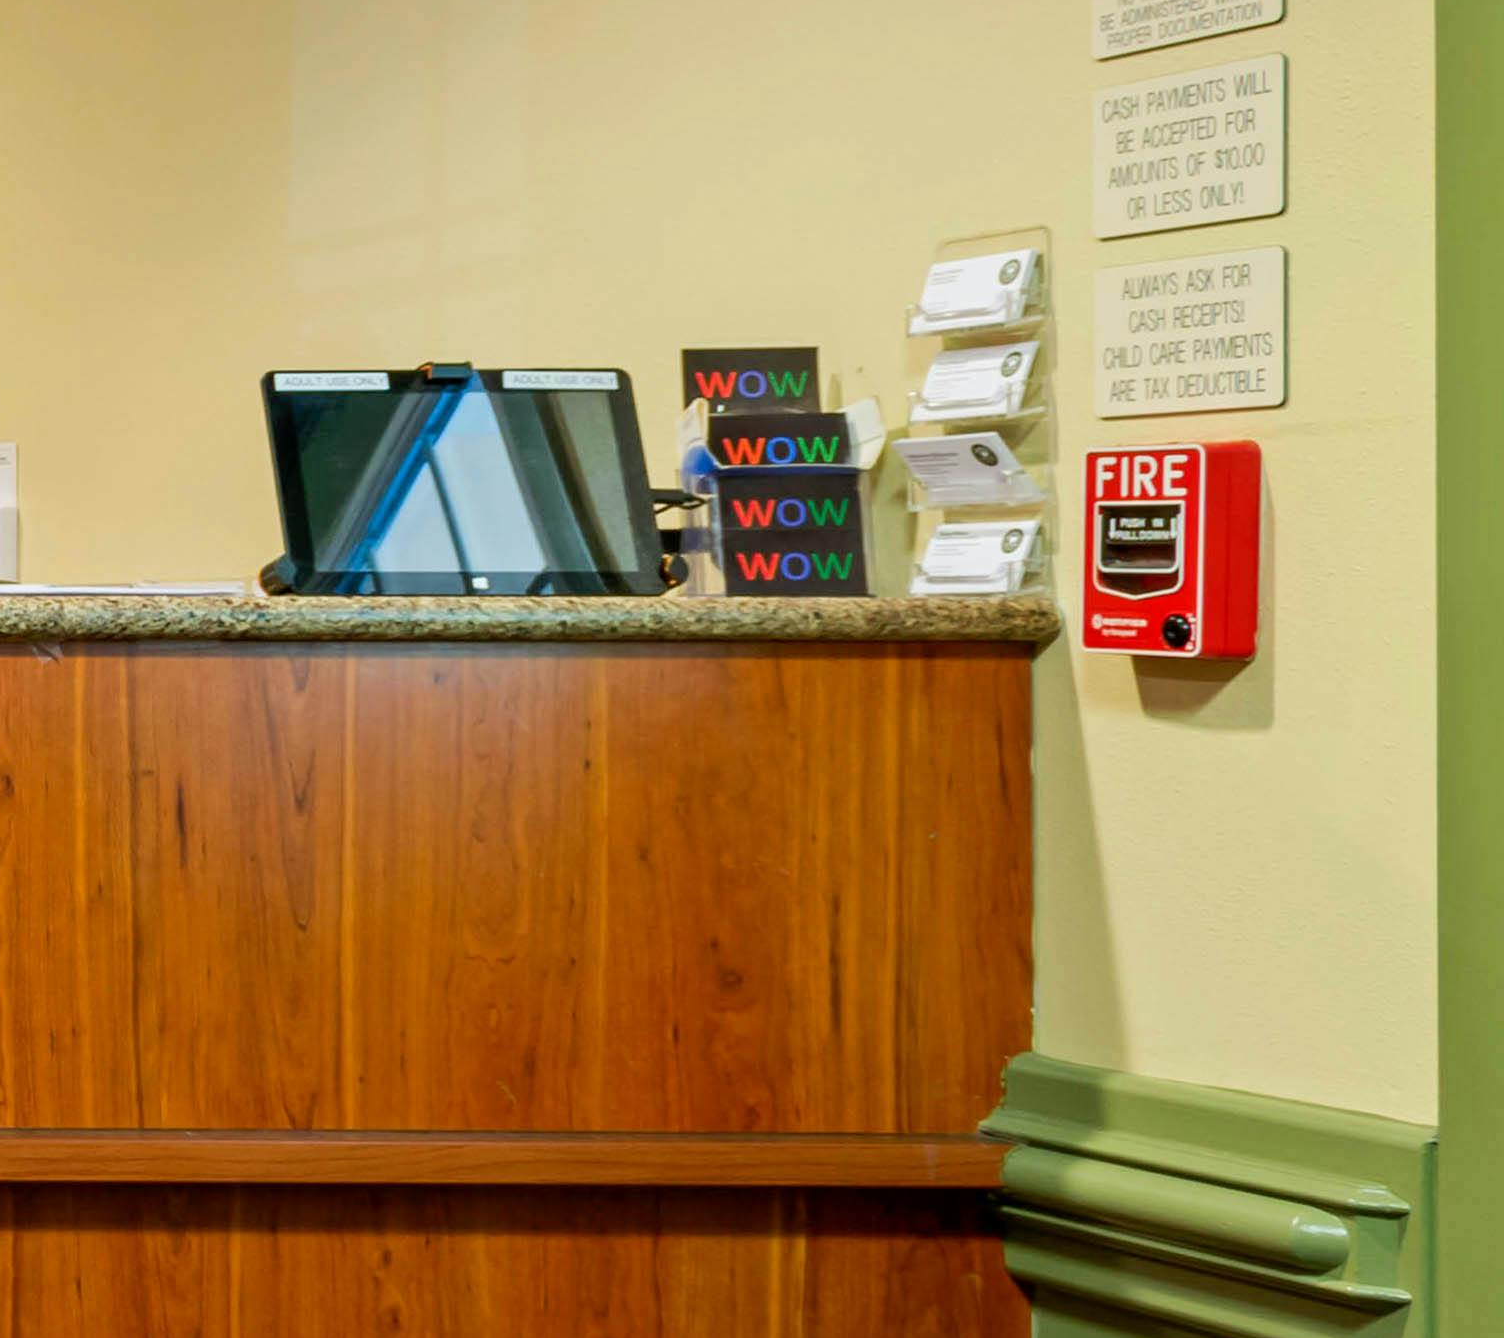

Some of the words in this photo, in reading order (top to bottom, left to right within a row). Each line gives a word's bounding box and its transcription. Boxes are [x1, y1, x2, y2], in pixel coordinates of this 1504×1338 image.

[1100, 14, 1115, 32] BE
[1107, 26, 1152, 48] PROPER
[1158, 3, 1263, 39] DOCUMENTATION
[1102, 95, 1140, 124] CASH
[1147, 78, 1226, 115] PAYMENTS
[1233, 69, 1272, 99] WILL
[1116, 129, 1135, 155] BE
[1141, 116, 1217, 149] ACCEPTED
[1225, 108, 1256, 136] FOR
[1108, 156, 1179, 189] AMOUNTS
[1186, 151, 1207, 177] OF
[1214, 142, 1265, 170] $10.00
[1127, 196, 1146, 220] OR
[1153, 188, 1192, 216] LESS
[1200, 181, 1245, 209] ONLY!
[1122, 272, 1178, 301] ALWAYS
[1186, 268, 1215, 293] ASK
[1222, 263, 1251, 289] FOR
[1128, 308, 1167, 334] CASH
[1102, 344, 1142, 370] CHILD
[1149, 340, 1186, 365] CARE
[1192, 332, 1273, 363] PAYMENTS
[694, 370, 809, 398] WOW
[1109, 379, 1136, 402] ARE
[1144, 377, 1170, 400] TAX
[1176, 368, 1267, 398] DEDUCTIBLE
[722, 436, 839, 465] WOW
[1095, 454, 1188, 498] FIRE
[732, 498, 849, 527] WOW
[737, 552, 853, 580] WOW
